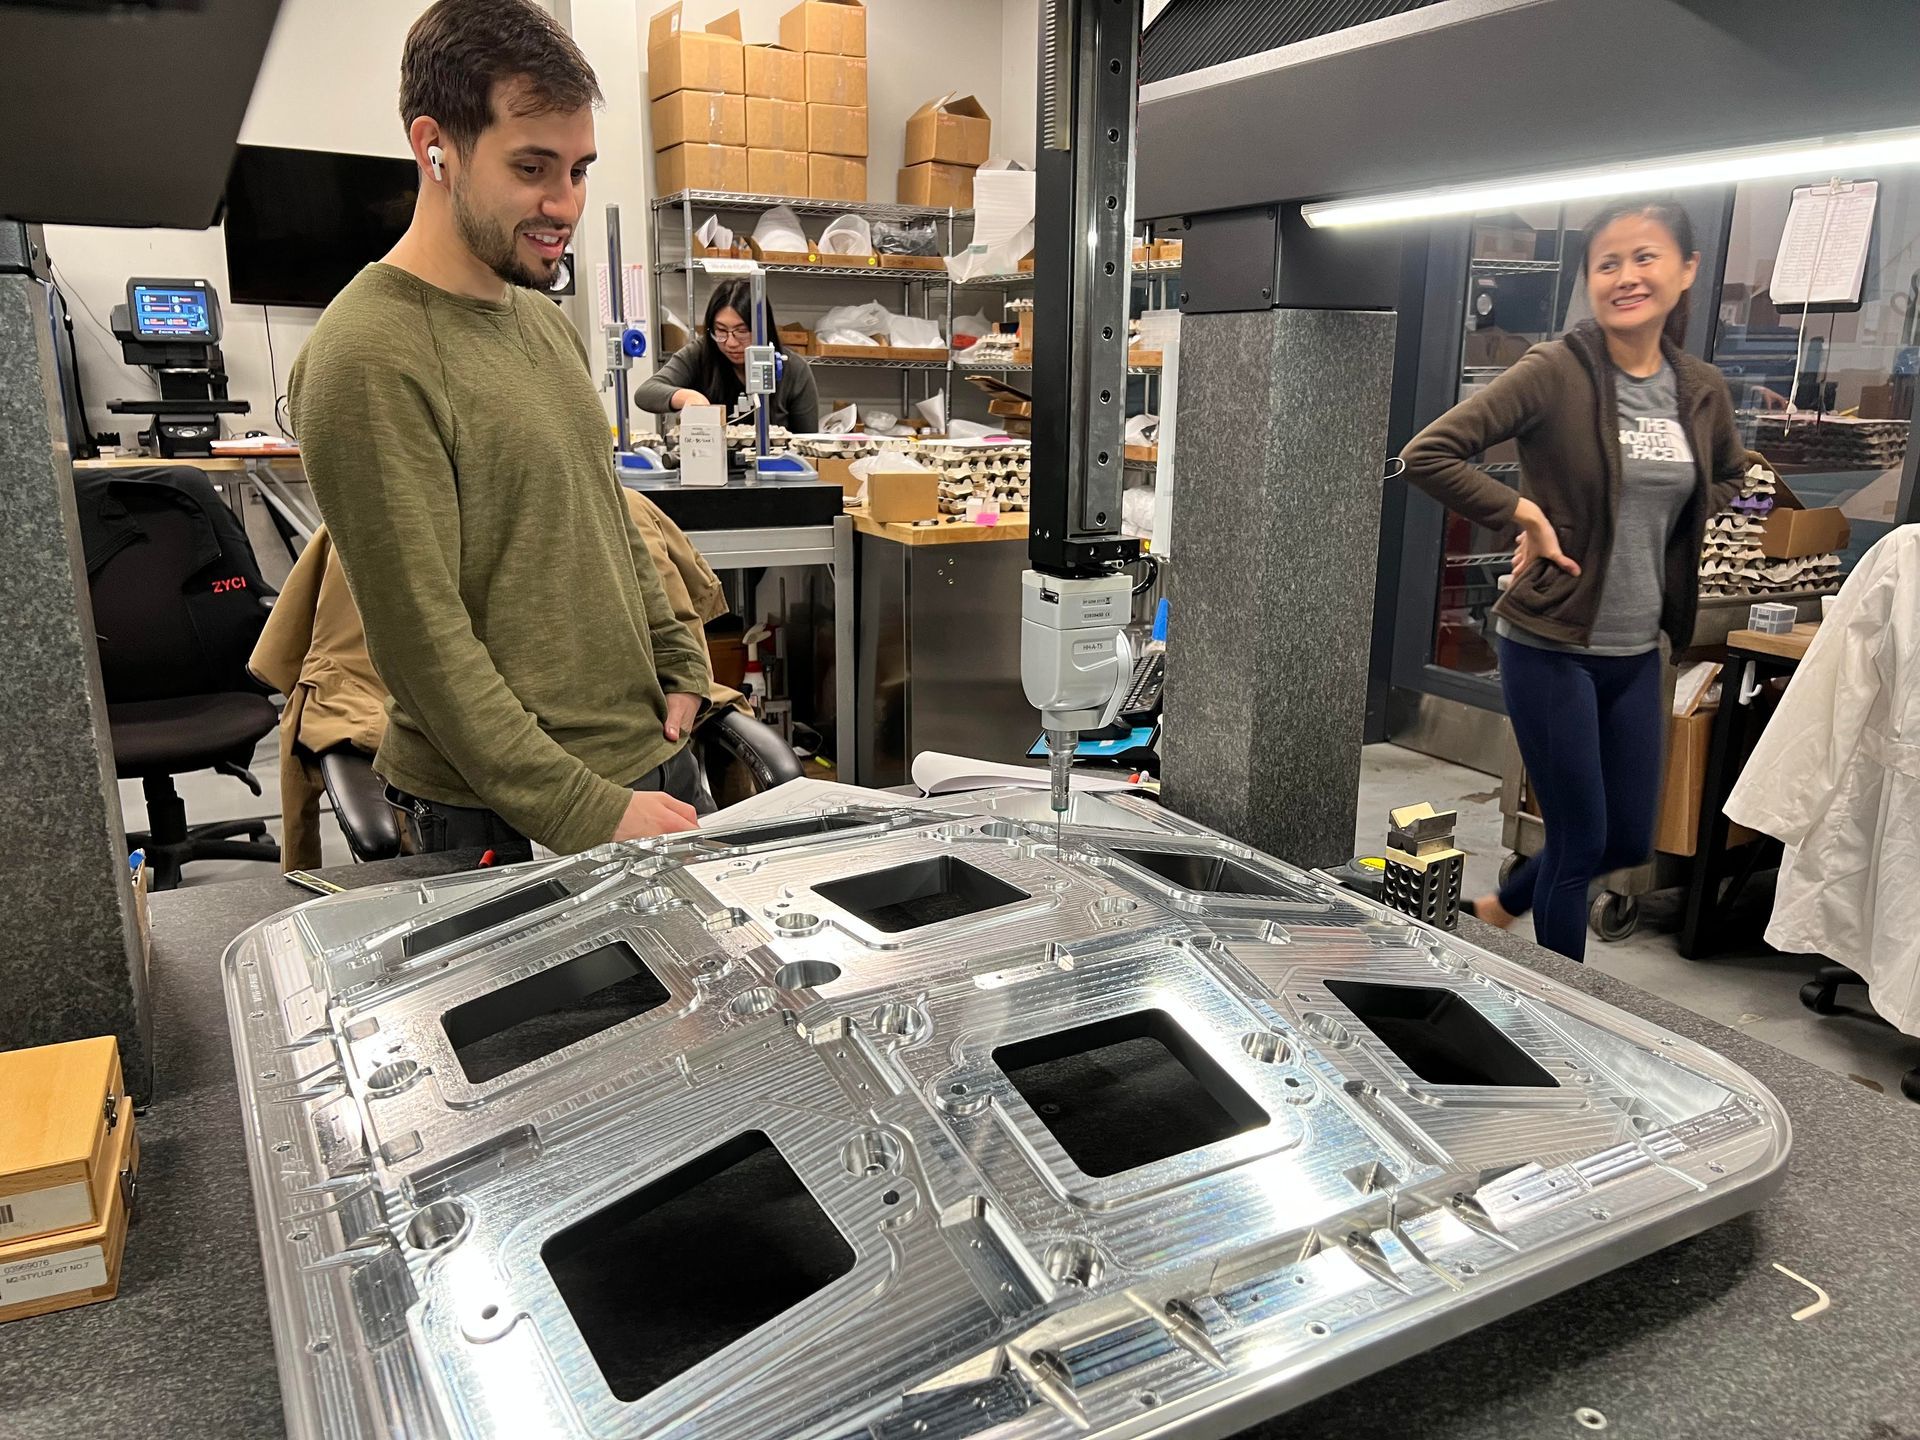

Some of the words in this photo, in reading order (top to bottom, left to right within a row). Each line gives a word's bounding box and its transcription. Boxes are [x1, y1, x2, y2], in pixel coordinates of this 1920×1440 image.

[1635, 417, 1667, 433] THE
[211, 576, 246, 593] ZYCI
[55, 1266, 67, 1274] KIT
